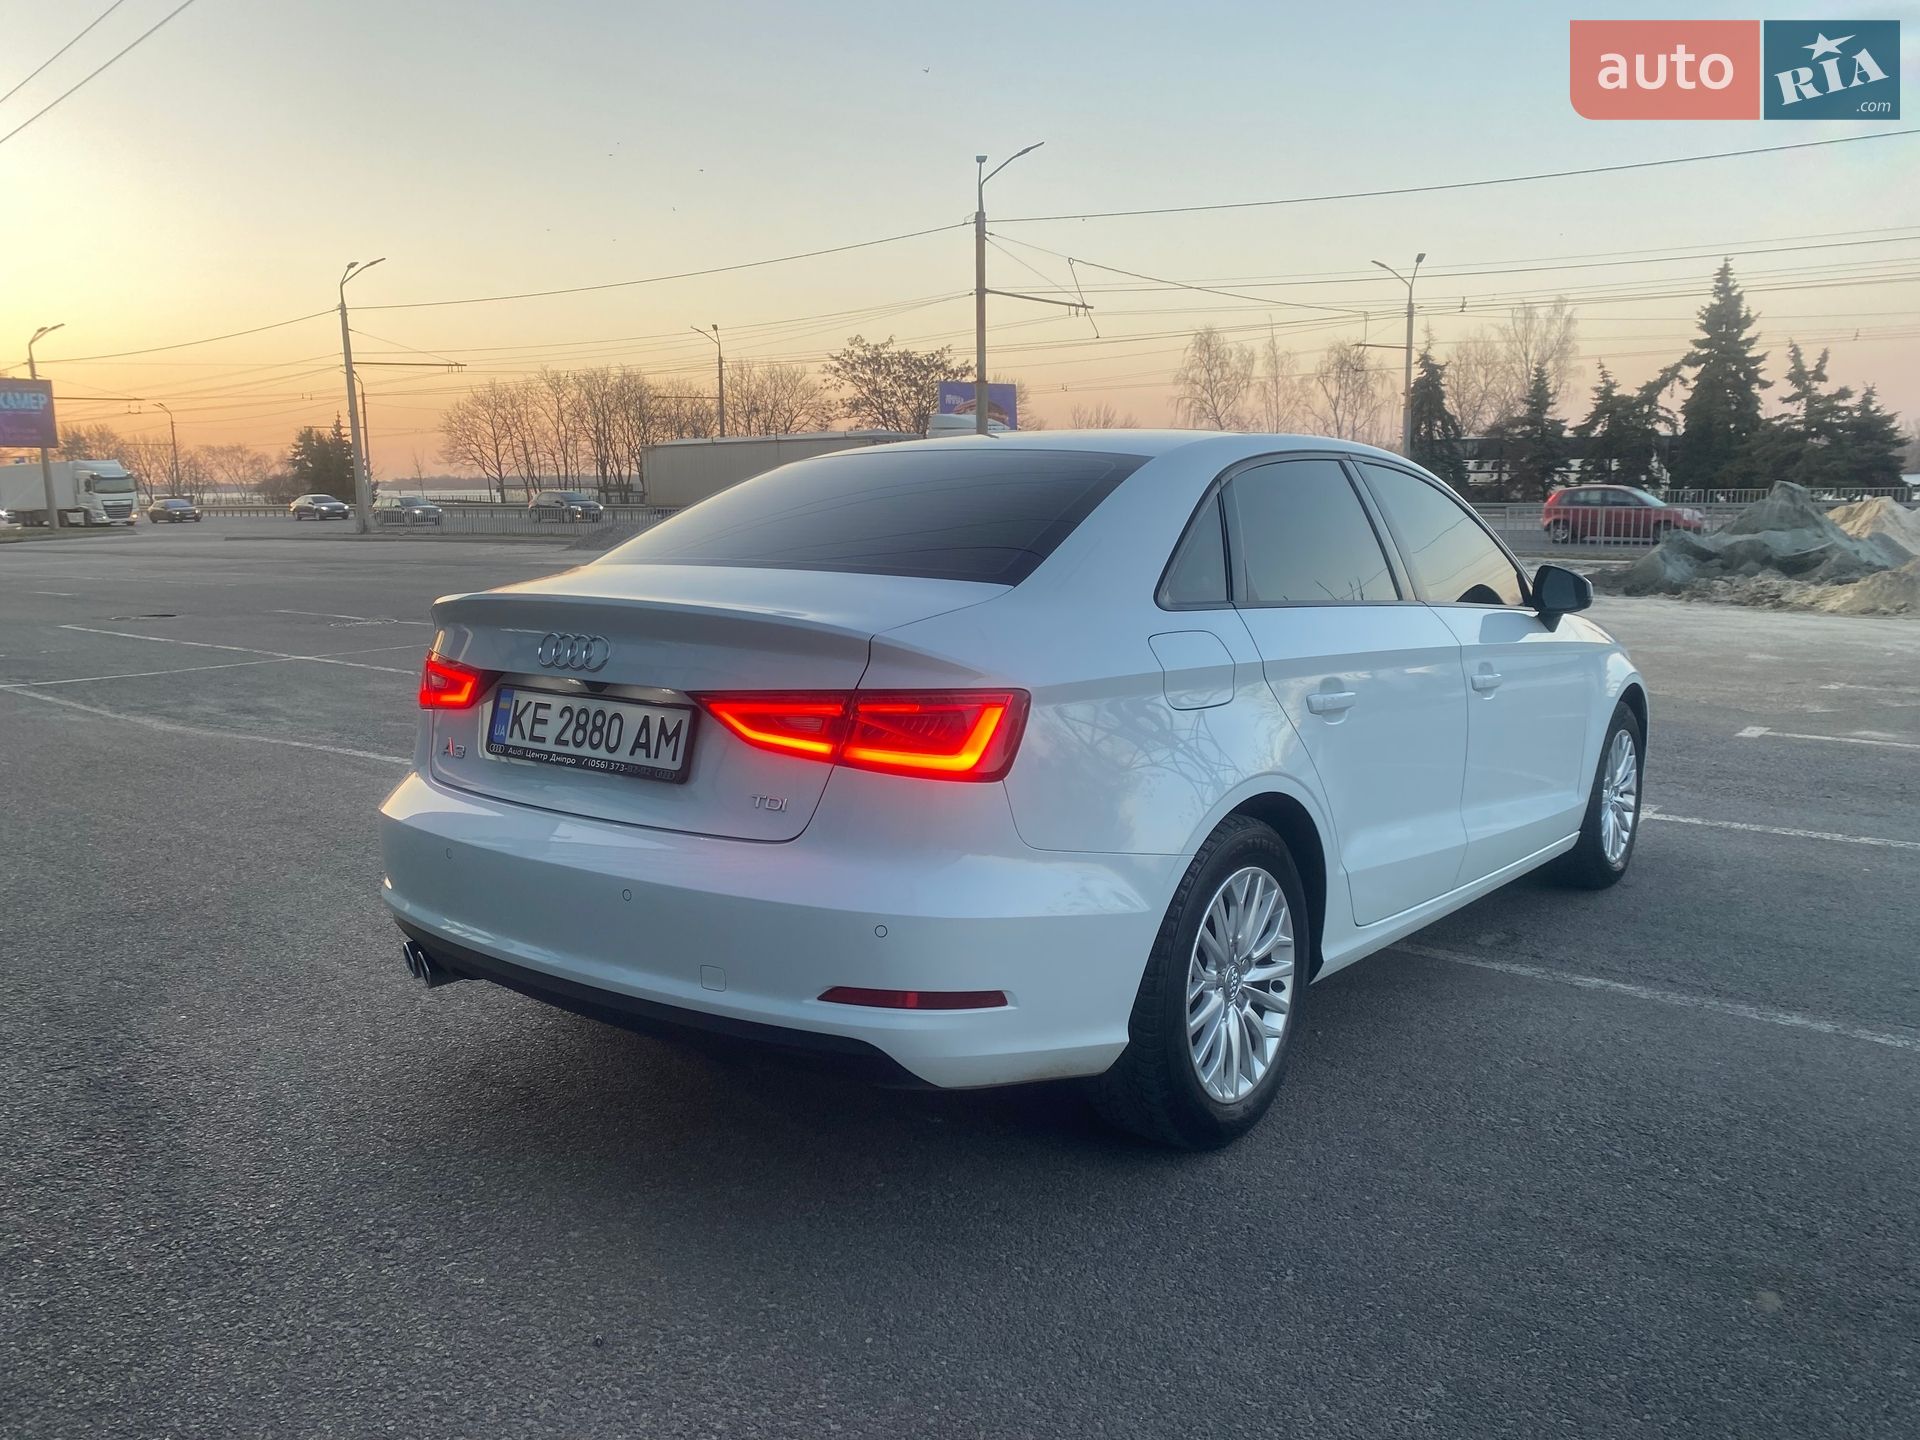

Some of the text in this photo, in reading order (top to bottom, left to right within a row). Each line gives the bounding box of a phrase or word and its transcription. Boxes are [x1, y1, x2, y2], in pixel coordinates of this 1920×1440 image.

[494, 724, 505, 736] UA
[508, 699, 683, 762] KE 2880 AM
[442, 736, 466, 758] A3
[508, 747, 524, 756] Audi
[526, 750, 548, 761] Центр
[550, 753, 576, 765] Дніпро
[752, 794, 788, 812] TDI
